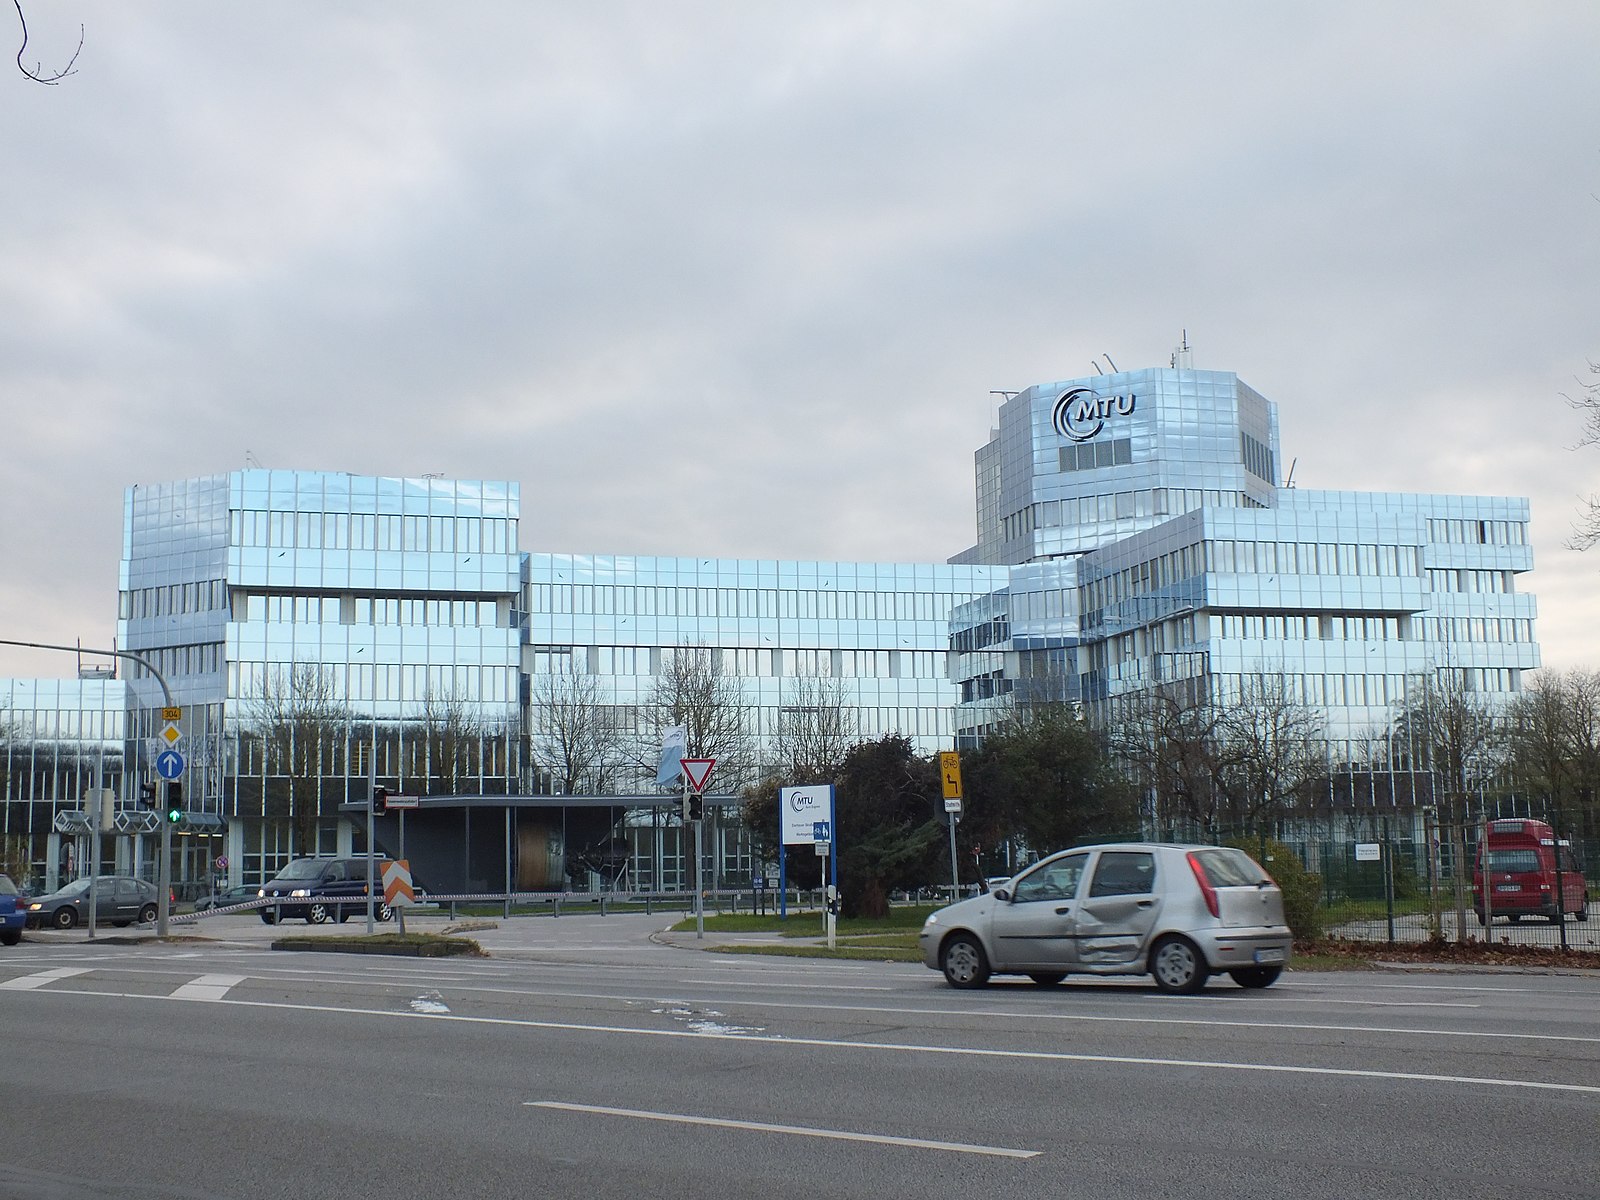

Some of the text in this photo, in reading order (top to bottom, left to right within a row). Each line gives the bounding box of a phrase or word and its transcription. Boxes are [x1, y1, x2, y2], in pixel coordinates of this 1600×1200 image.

[1075, 393, 1136, 422] MTU
[164, 710, 178, 718] 304
[797, 796, 814, 805] MTU
